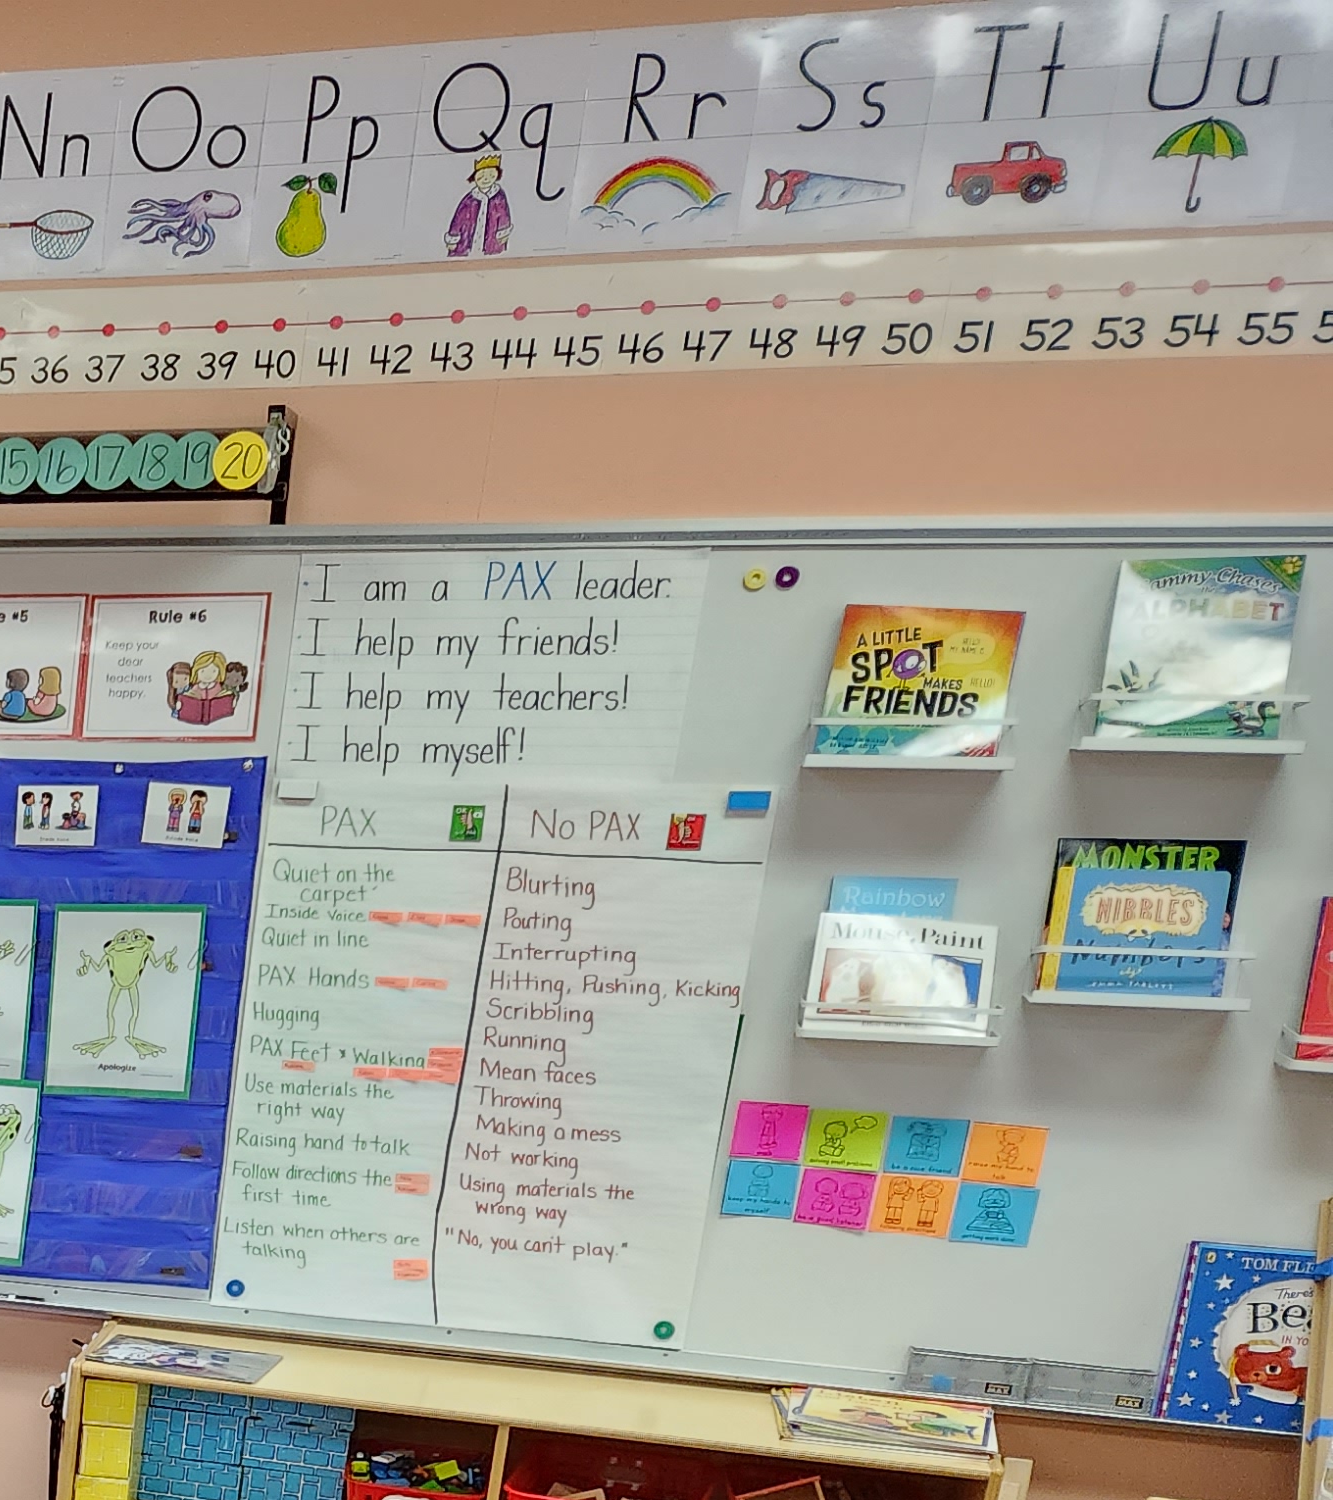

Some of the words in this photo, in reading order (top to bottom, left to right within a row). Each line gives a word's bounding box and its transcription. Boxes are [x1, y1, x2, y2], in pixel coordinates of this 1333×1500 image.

[33, 356, 69, 384] 36
[254, 350, 295, 380] 40
[683, 330, 732, 364] 47
[1238, 312, 1295, 344] 55
[44, 448, 79, 479] 16
[223, 441, 262, 479] 20
[310, 563, 340, 602] I
[364, 580, 406, 602] am
[432, 580, 449, 602] a
[484, 560, 557, 601] PAX
[575, 561, 672, 600] leader.
[1216, 567, 1282, 594] Chases
[12, 610, 29, 623] #5
[300, 618, 329, 657] I
[356, 617, 414, 670] help
[436, 631, 479, 669] my
[498, 617, 618, 656] friends!
[857, 633, 867, 648] A
[873, 628, 921, 646] LITTLE
[851, 640, 943, 684] SPOT
[106, 673, 152, 683] teachers
[923, 678, 962, 691] MAKES
[296, 671, 323, 710] I
[347, 672, 401, 725] help
[426, 687, 470, 725] my
[493, 673, 628, 710] teachers!
[842, 686, 979, 718] FRIENDS
[290, 724, 319, 762] I
[343, 725, 399, 776] help
[320, 805, 376, 837] PAX
[531, 810, 575, 840] No
[590, 811, 640, 841] PAX
[1072, 842, 1220, 871] MONSTER
[507, 867, 596, 910] Blurting
[844, 886, 946, 908] Rainbow
[503, 909, 572, 941] Pouting
[1096, 897, 1195, 926] NIBBLES
[920, 928, 983, 950] Paint
[493, 943, 637, 977] Interrupting
[258, 964, 295, 988] PAX
[309, 967, 369, 989] Hands
[254, 1002, 319, 1030] Hugging
[486, 998, 595, 1033] Scribbling
[484, 1028, 566, 1066] Running
[245, 1073, 278, 1096] Use
[281, 1076, 359, 1100] materials
[365, 1079, 394, 1101] the
[480, 1060, 536, 1084] Mean
[546, 1061, 596, 1085] faces
[257, 1101, 304, 1119] right
[310, 1105, 345, 1126] way
[474, 1085, 563, 1119] Throwing
[465, 1143, 501, 1164] Not
[512, 1152, 579, 1173] working
[232, 1162, 281, 1183] Follow
[285, 1165, 357, 1186] directions
[362, 1167, 393, 1188] the
[460, 1174, 505, 1203] Using
[516, 1178, 598, 1199] materials
[606, 1178, 635, 1201] the
[242, 1184, 283, 1205] first
[292, 1191, 332, 1208] time
[476, 1201, 526, 1224] wrong
[536, 1205, 567, 1228] way
[1242, 1257, 1277, 1271] TOM
[1275, 1287, 1313, 1300] There's
